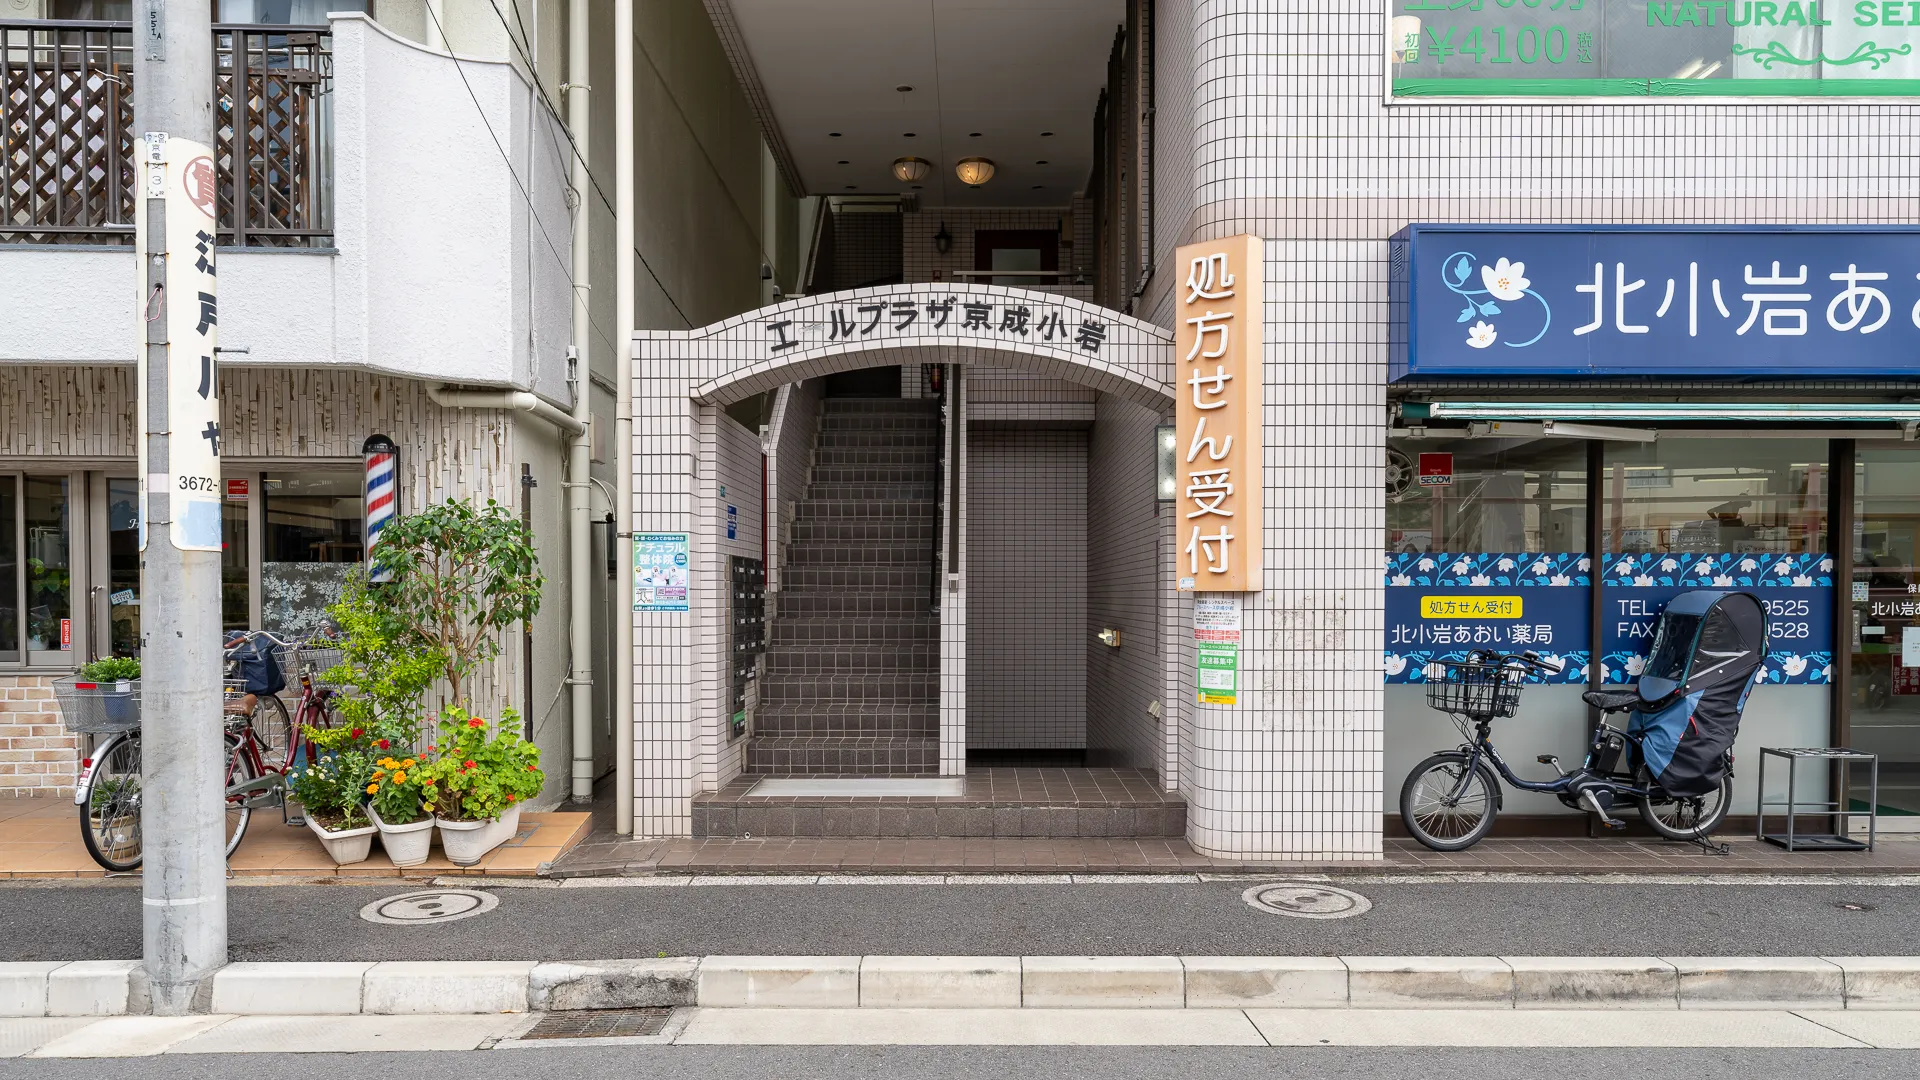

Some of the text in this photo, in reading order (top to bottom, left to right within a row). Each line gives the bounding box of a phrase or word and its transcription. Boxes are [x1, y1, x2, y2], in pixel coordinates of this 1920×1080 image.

[1647, 1, 1832, 27] NATURAL
[1404, 24, 1593, 64] 初回 ¥4100 税込
[1573, 260, 1920, 337] 北小岩あ
[1185, 251, 1236, 575] 処方せん受付
[1420, 475, 1451, 484] SECOM
[635, 542, 685, 553] ナチュラル
[639, 554, 674, 565] 整体院
[1429, 600, 1513, 615] 処方せん受付
[1391, 624, 1553, 645] 北小岩あおい薬局
[1201, 656, 1234, 666] 友達募集中
